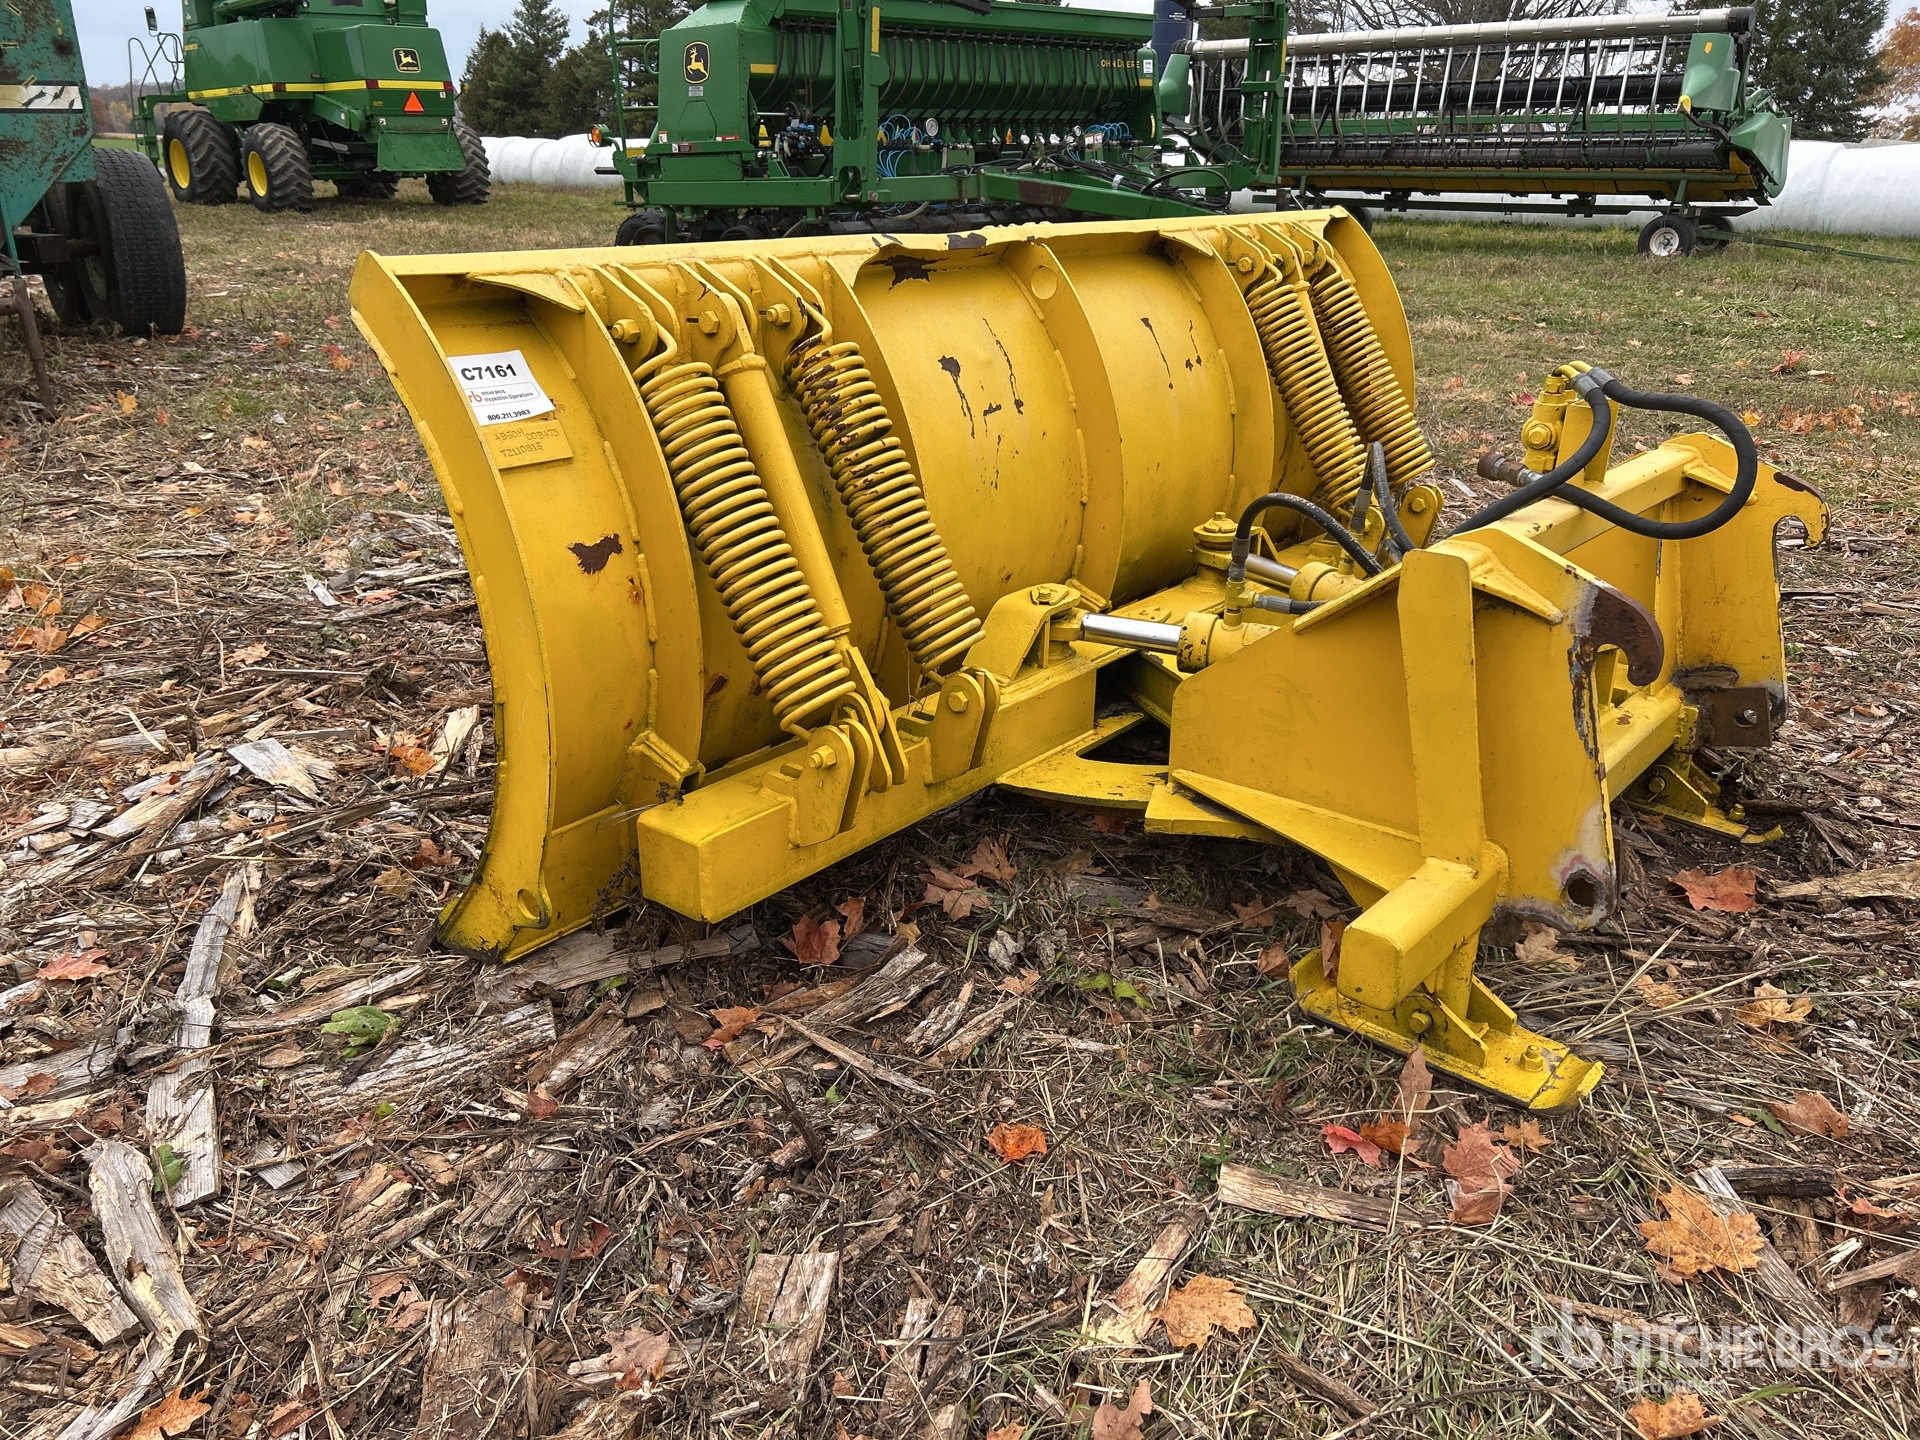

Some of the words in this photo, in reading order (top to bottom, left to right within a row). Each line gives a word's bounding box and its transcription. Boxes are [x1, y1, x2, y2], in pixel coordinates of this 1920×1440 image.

[1116, 58, 1140, 69] DERE
[461, 363, 517, 381] C7161
[467, 390, 483, 403] rb
[483, 394, 508, 402] Inspection
[508, 392, 534, 400] Operations
[487, 409, 531, 421] 800.211.3983
